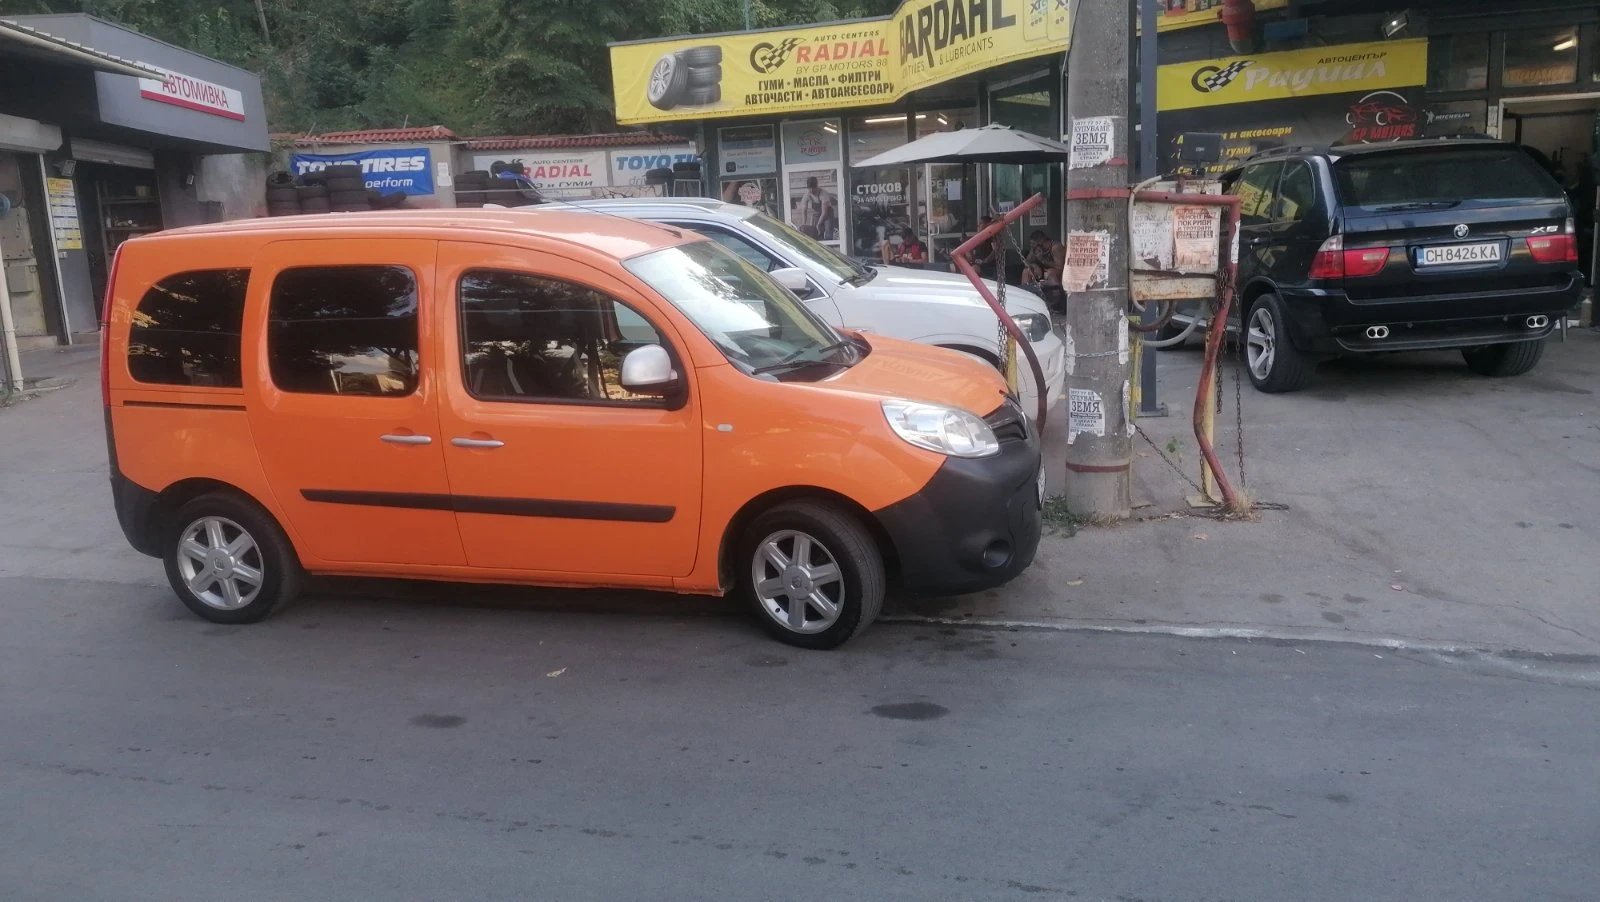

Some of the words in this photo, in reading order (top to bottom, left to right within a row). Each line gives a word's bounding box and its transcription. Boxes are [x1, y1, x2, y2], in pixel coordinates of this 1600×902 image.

[814, 33, 838, 42] AUTO
[840, 30, 880, 40] CENTERS
[899, 0, 1016, 68] BARDAHL
[795, 38, 890, 64] RADIAL
[945, 37, 994, 63] LUBRICANTS
[1317, 52, 1388, 65] АВТОЦЕНТЪР
[795, 65, 809, 75] BY
[811, 63, 826, 74] GP
[828, 60, 873, 72] MOTORS
[876, 58, 888, 69] 88
[758, 78, 785, 91] ГУМИ
[793, 75, 829, 89] МАСЛА
[838, 70, 881, 83] ФИЛТРИ
[162, 74, 229, 108] АВТОМИВКА
[745, 90, 803, 106] АВТОЧАСТИ
[1076, 132, 1107, 145] ЗЕМЯ
[1239, 126, 1293, 139] аксесоари
[1370, 124, 1416, 139] MOTORS
[360, 156, 426, 173] TIRES
[616, 154, 672, 170] TOYO
[523, 164, 593, 179] RADIAL
[364, 176, 414, 189] perform
[558, 180, 593, 188] ГУМИ
[856, 182, 902, 195] СТОКОВ
[1177, 219, 1213, 227] ПОКРИВИ
[1531, 225, 1559, 234] X5
[1445, 246, 1478, 261] 8426
[1480, 245, 1498, 259] KA
[1071, 401, 1101, 412] ЗЕМЯ
